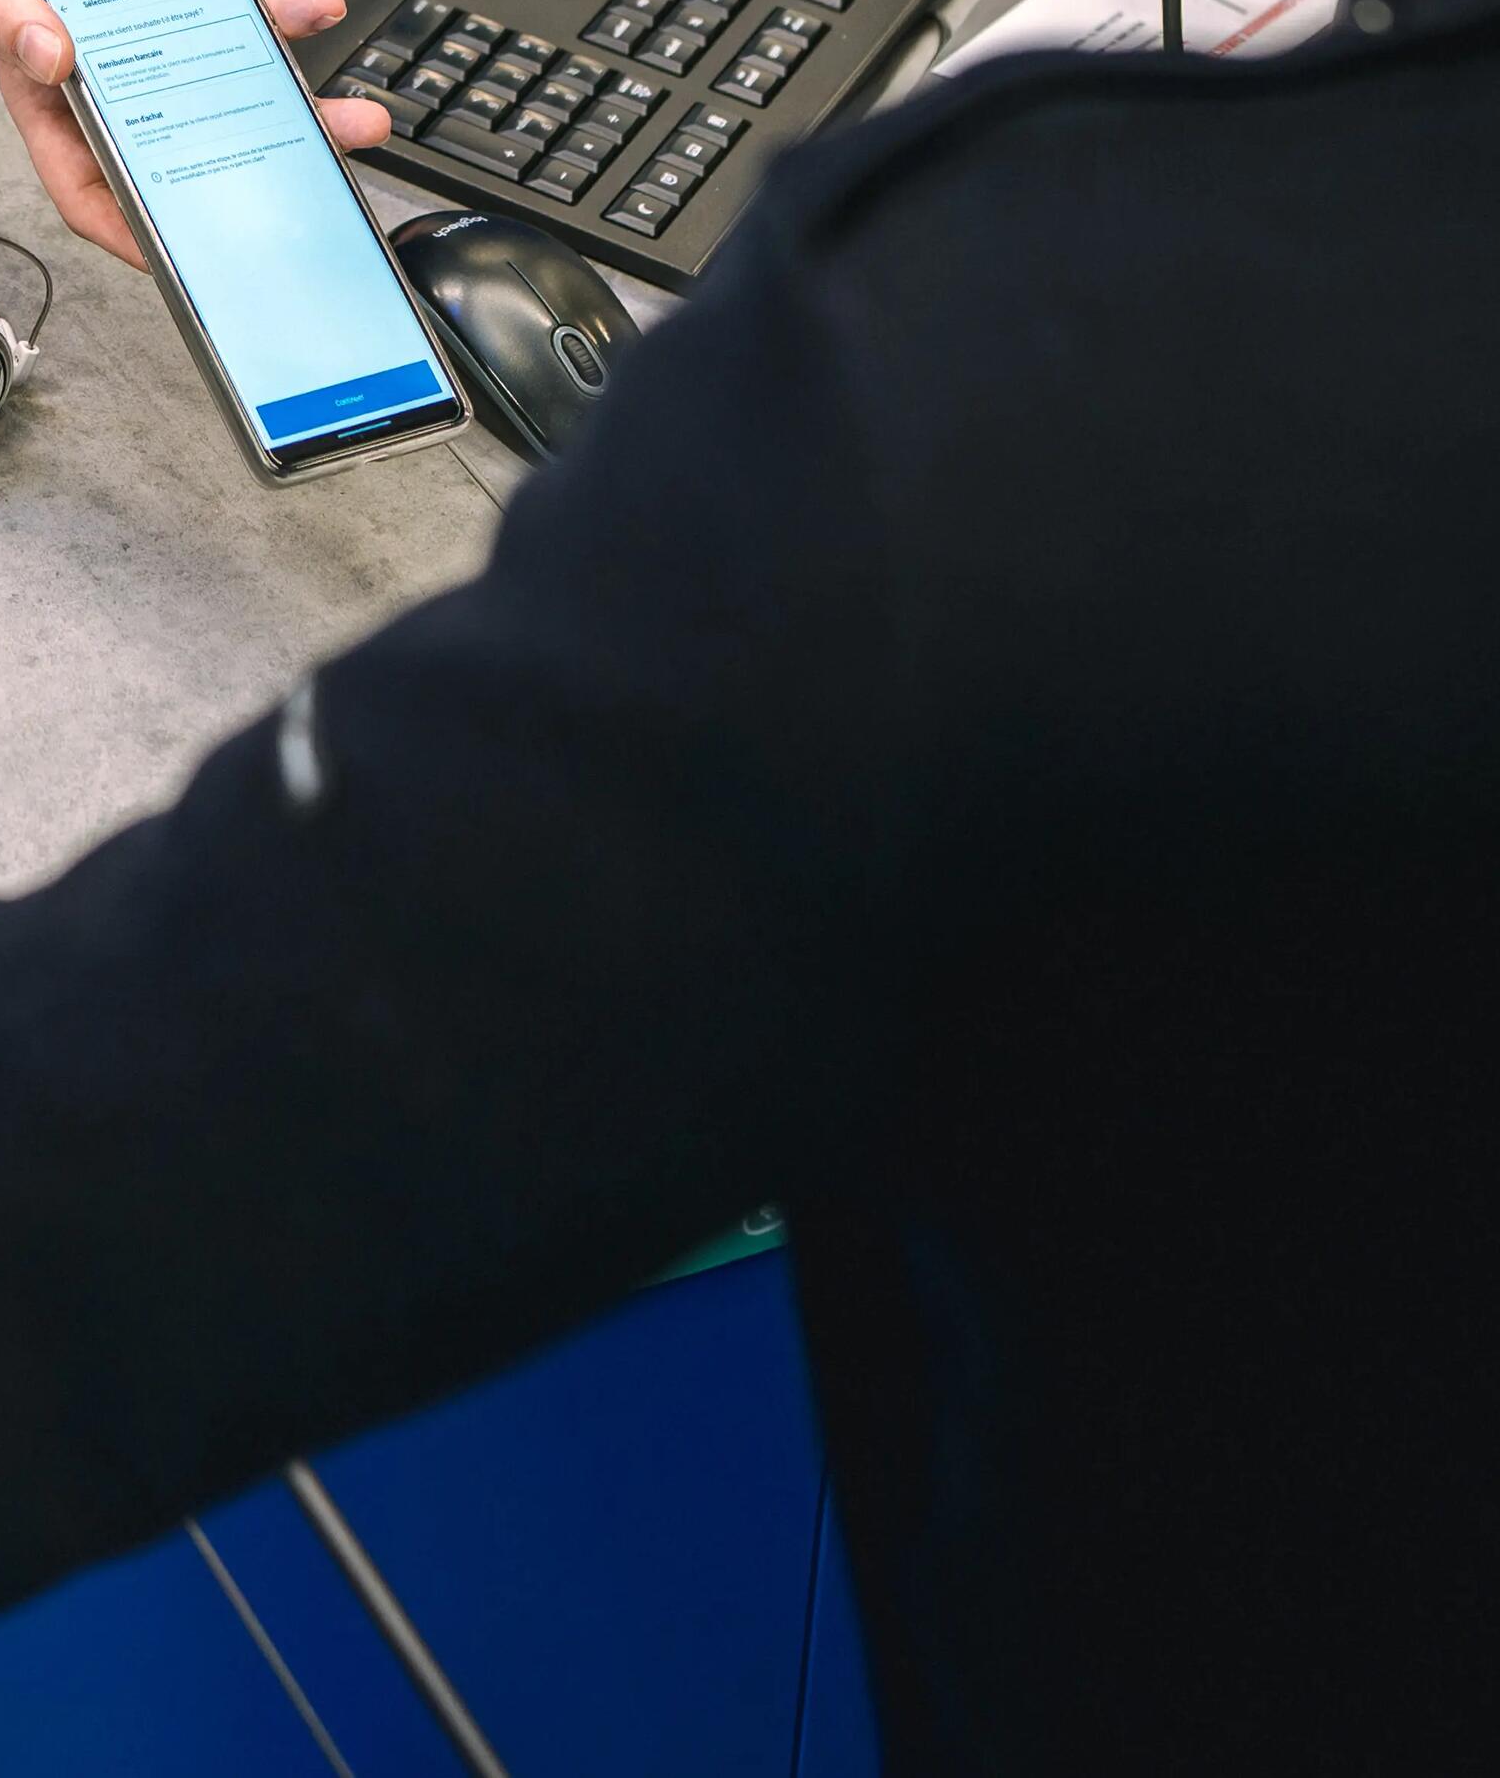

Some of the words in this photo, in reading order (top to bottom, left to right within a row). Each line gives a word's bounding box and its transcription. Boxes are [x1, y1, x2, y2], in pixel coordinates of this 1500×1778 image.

[76, 30, 106, 44] Comment
[98, 54, 134, 70] Rétribution
[134, 47, 162, 61] bancaire
[125, 116, 139, 126] Bon
[431, 215, 489, 238] logitech
